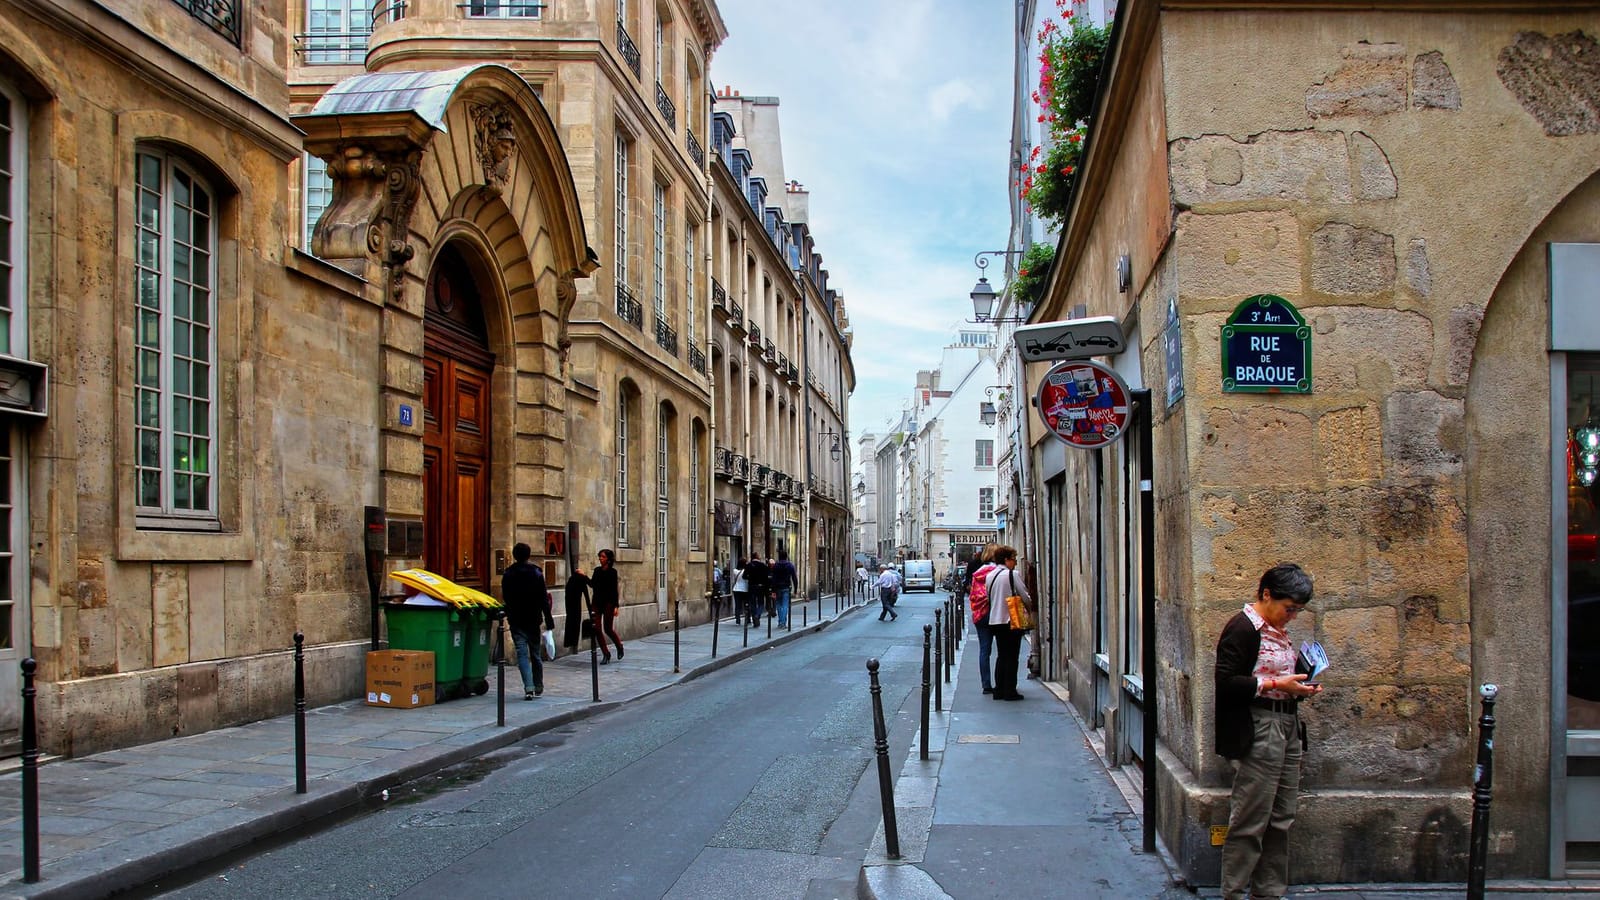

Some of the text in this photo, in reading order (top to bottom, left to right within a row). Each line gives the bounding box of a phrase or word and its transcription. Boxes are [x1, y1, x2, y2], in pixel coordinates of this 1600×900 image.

[1250, 336, 1281, 352] RUE
[1260, 354, 1271, 363] DE
[1236, 366, 1296, 383] BRAQUE
